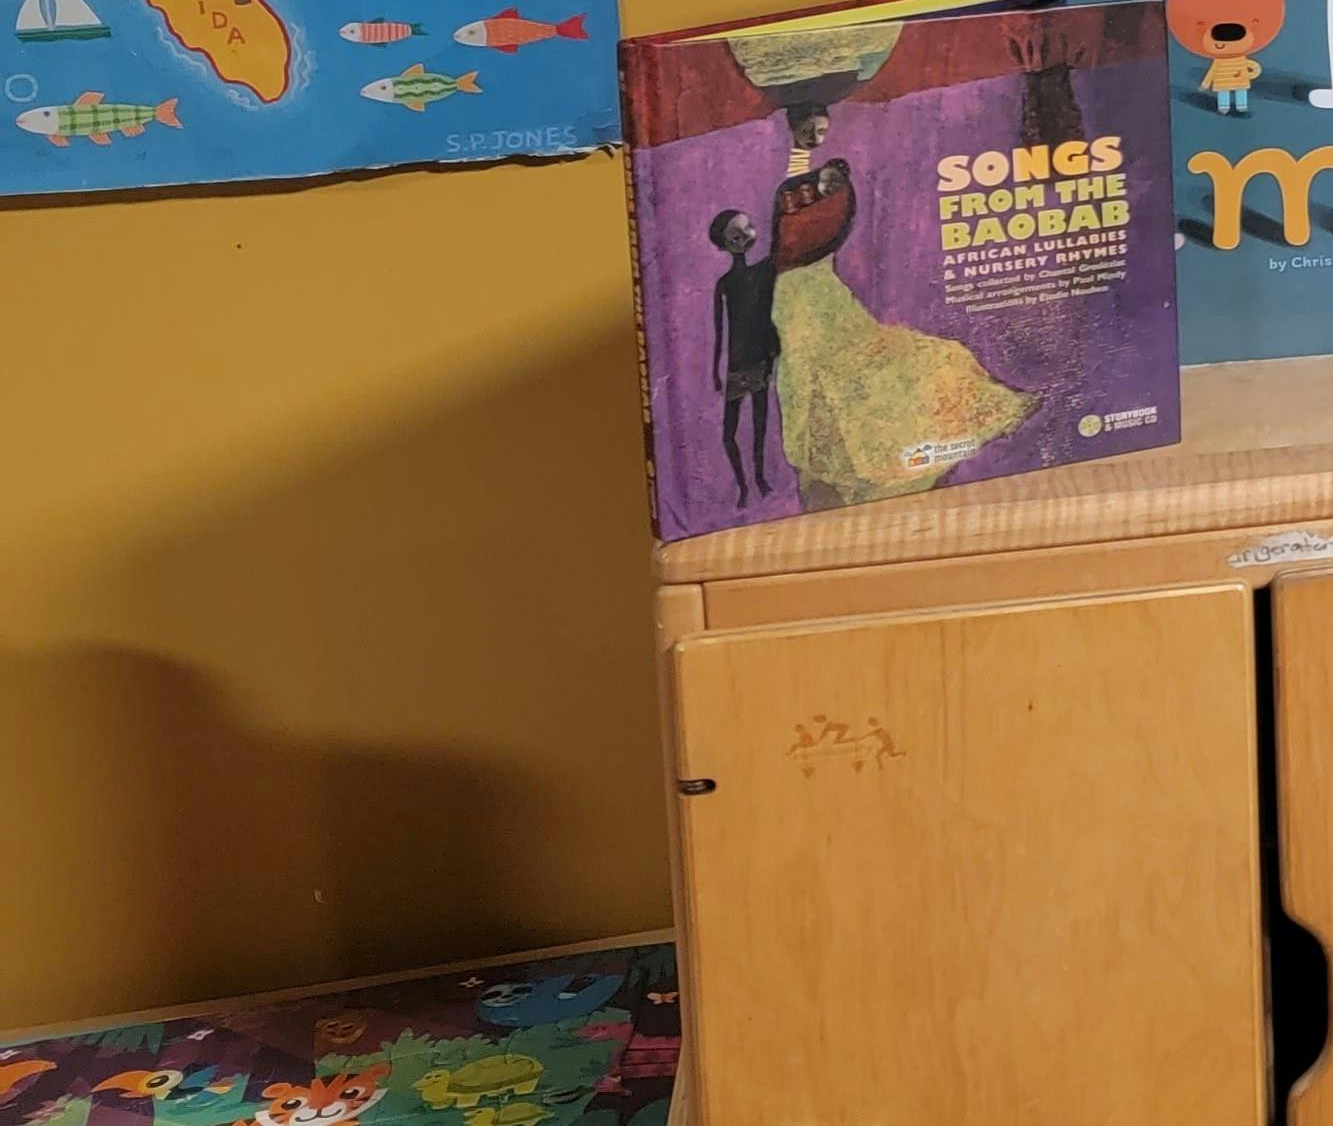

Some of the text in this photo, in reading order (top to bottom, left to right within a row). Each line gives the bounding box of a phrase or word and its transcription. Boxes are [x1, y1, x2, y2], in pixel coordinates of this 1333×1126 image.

[937, 136, 1123, 192] SONGS
[939, 173, 1127, 220] FROM THE
[941, 200, 1130, 250] BAOBAB
[943, 230, 1127, 266] AFRICAN LULLABIES
[944, 244, 1127, 280] & NURSERY RHYMES
[1269, 258, 1287, 272] by
[1291, 255, 1333, 268] Chris
